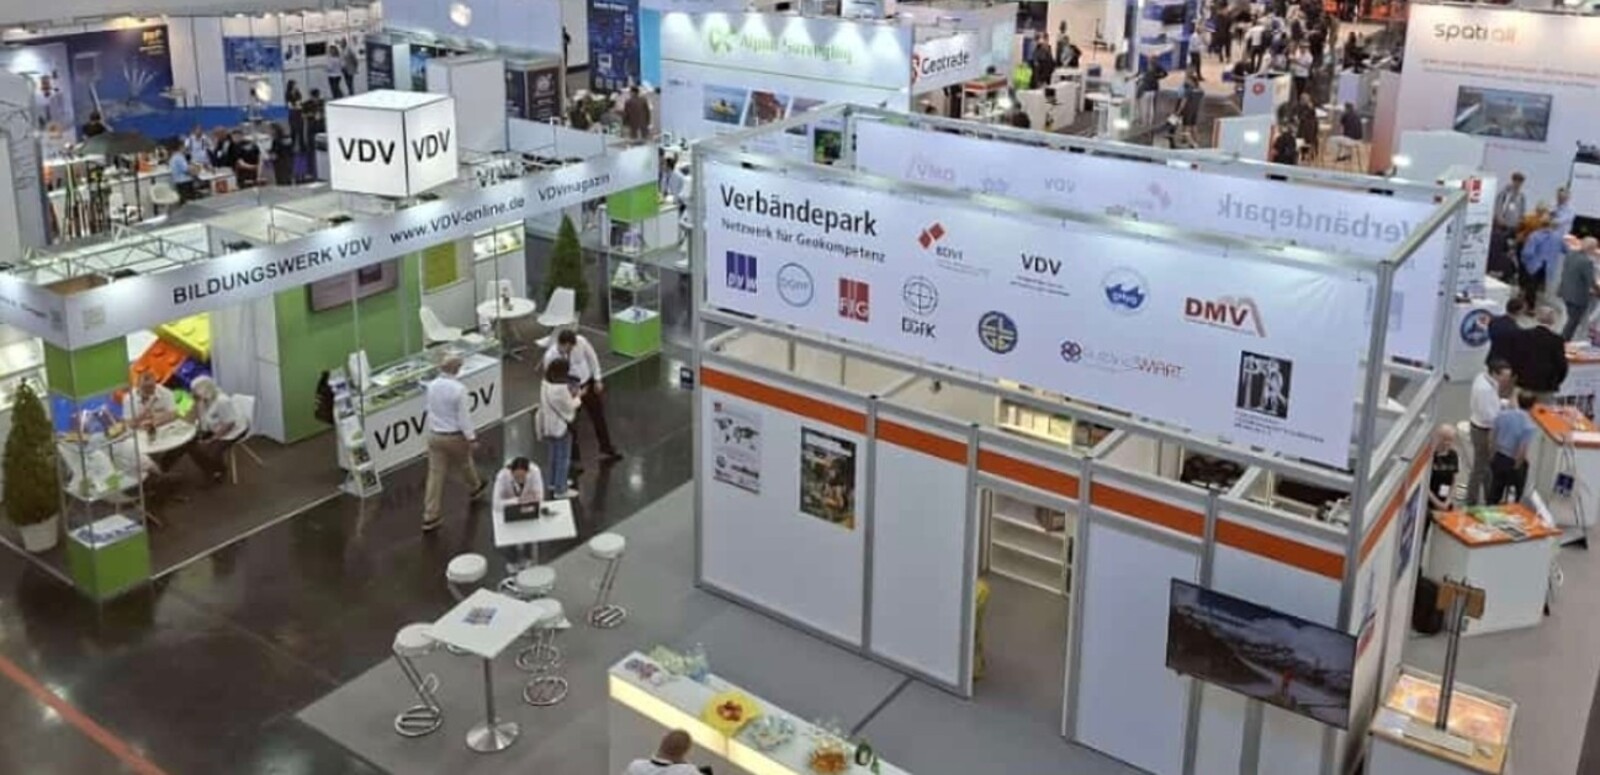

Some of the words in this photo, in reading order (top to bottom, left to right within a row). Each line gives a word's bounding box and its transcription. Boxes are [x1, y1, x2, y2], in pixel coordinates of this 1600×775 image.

[922, 50, 970, 76] Geotrade
[338, 137, 395, 165] VDV
[412, 128, 450, 162] VDV
[390, 196, 525, 245] www.VDV-online.de
[720, 183, 878, 236] Verbändepark
[721, 217, 773, 240] Netzwerk
[795, 233, 886, 263] Geokompetenz
[173, 246, 332, 304] BILDUNGSWERK
[337, 236, 372, 259] VDV
[1021, 252, 1062, 275] VDV
[1185, 297, 1249, 327] DMV
[374, 410, 428, 450] VDV
